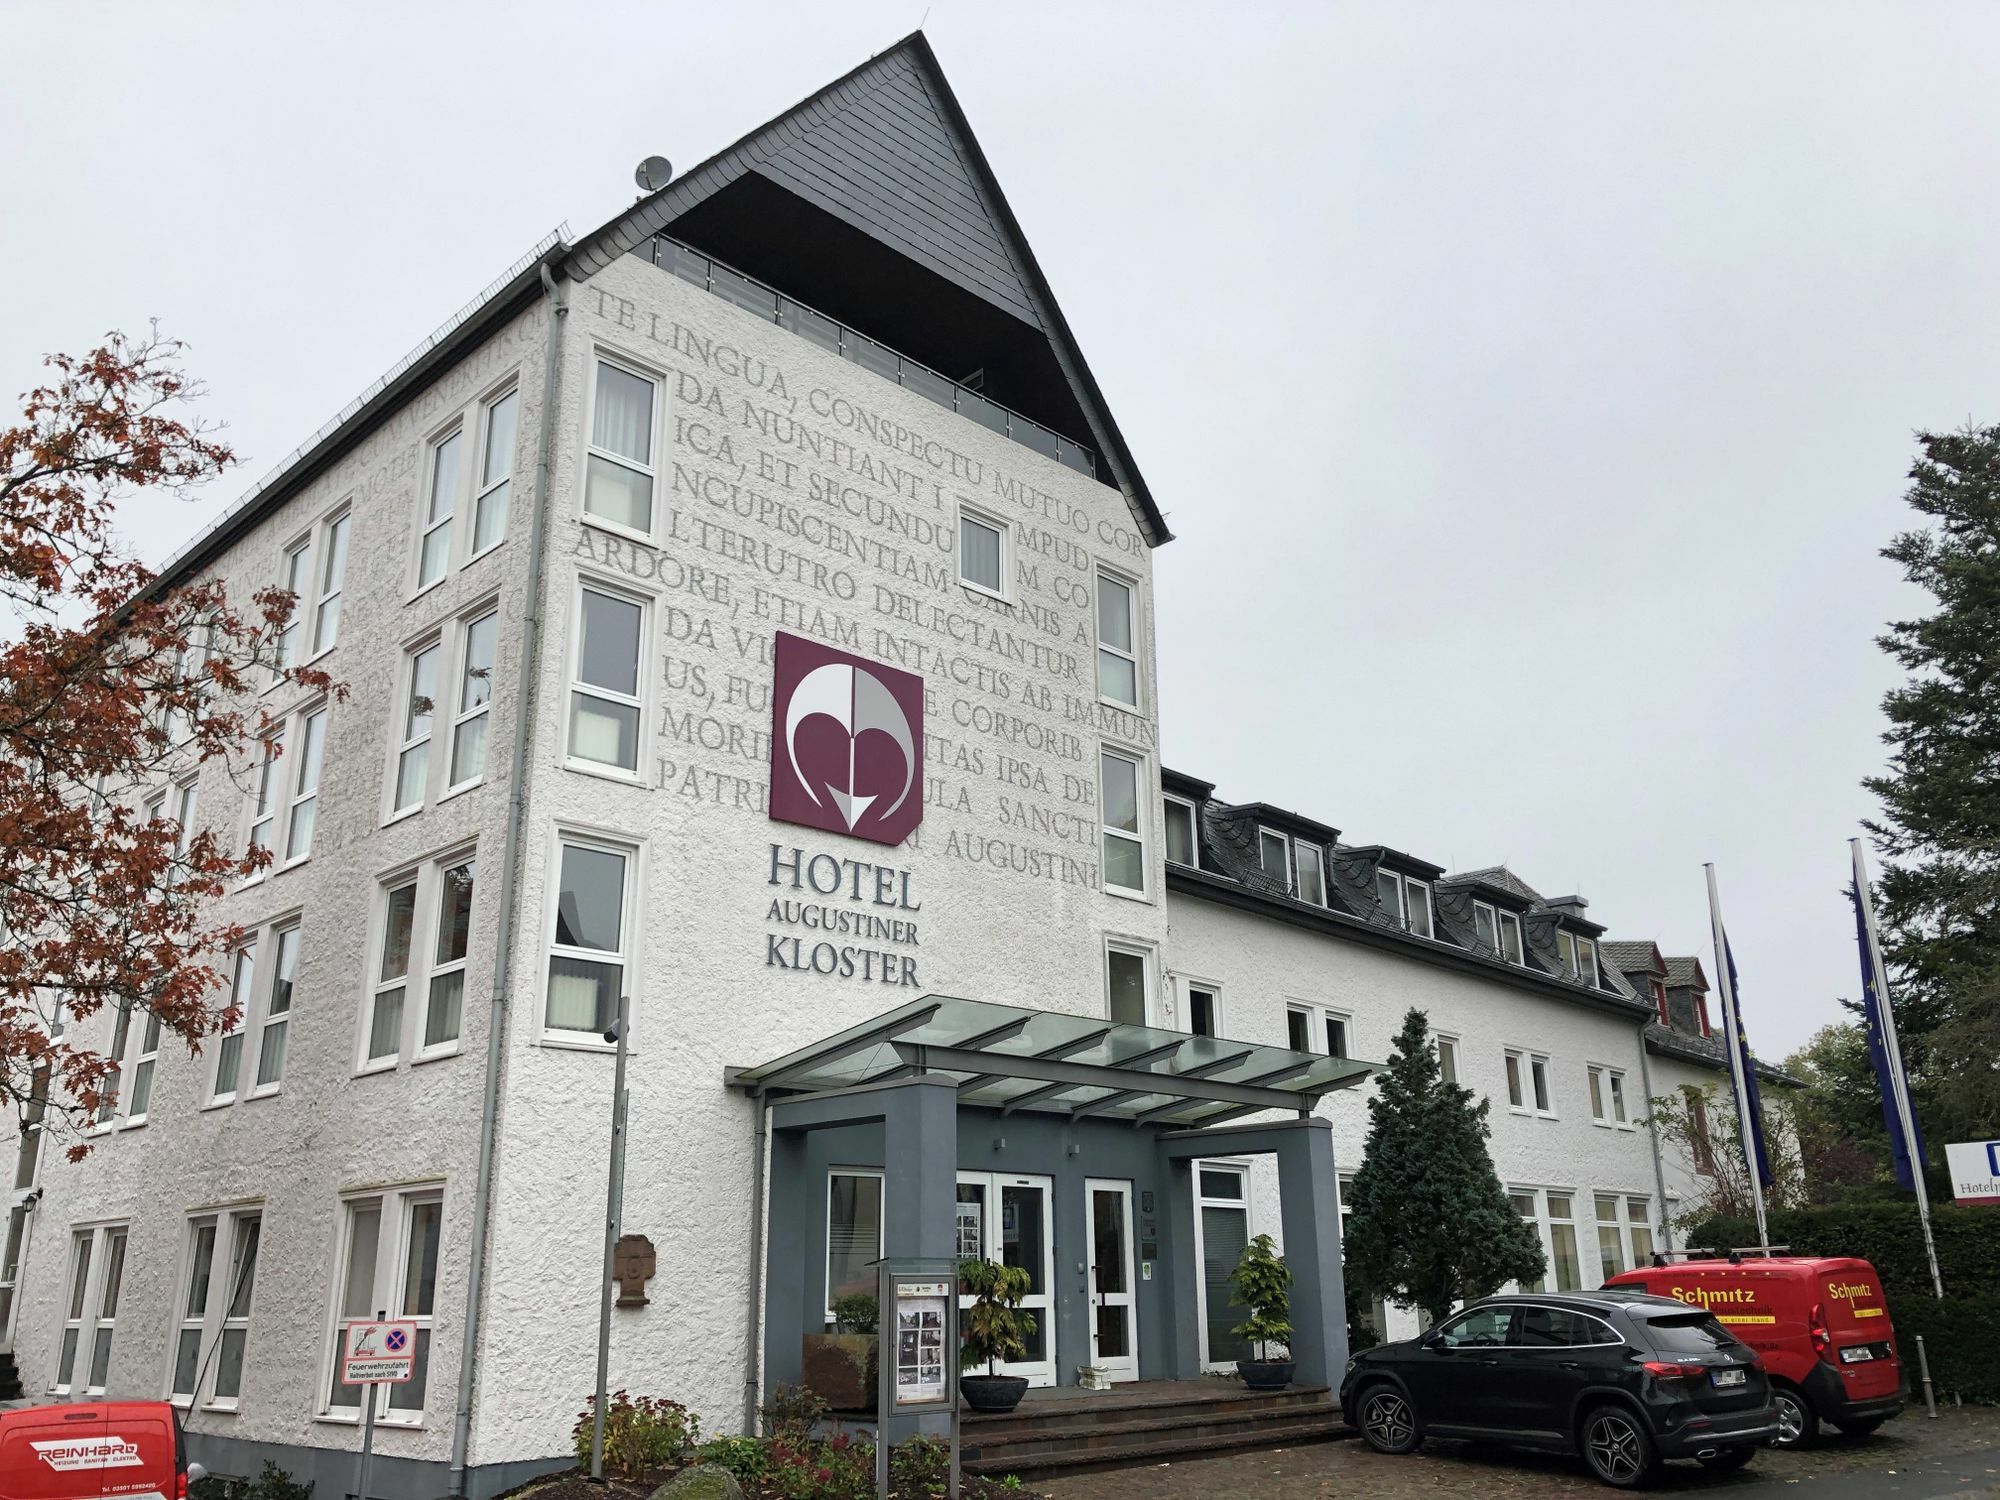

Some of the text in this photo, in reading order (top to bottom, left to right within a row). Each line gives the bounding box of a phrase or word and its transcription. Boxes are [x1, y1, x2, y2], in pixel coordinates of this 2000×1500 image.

[589, 285, 1146, 562] TE LINGUA, CONSPECTU MUTUO COR
[675, 370, 1089, 572] DA NUNTIANT I MPUD
[672, 461, 948, 594] NCUPISCENTIAM
[1073, 622, 1090, 647] A
[674, 415, 1089, 608] ICA, ET SECUNDU M CO
[570, 528, 1157, 748] ARDORE, ETIAM INTACTIS AB IMMUN
[668, 508, 1082, 686] LTERUTRO DELECTANTUR
[662, 655, 716, 713] US,
[723, 673, 770, 713] FU
[997, 754, 1050, 795] IPSA
[1063, 773, 1095, 806] DE
[664, 605, 718, 650] DA
[952, 699, 1082, 762] CORPORIB
[656, 757, 770, 815] PATRI
[945, 829, 1098, 890] AUGUSTINI
[767, 842, 922, 912] HOTEL
[999, 796, 1098, 848] SANCTI
[766, 898, 920, 945] AUGUSTINER
[766, 933, 921, 988] KLOSTER
[347, 1362, 409, 1371] Feuerwehrzufahrt
[1671, 1286, 1756, 1311] Schmitz
[1828, 1282, 1873, 1309] Schmitz
